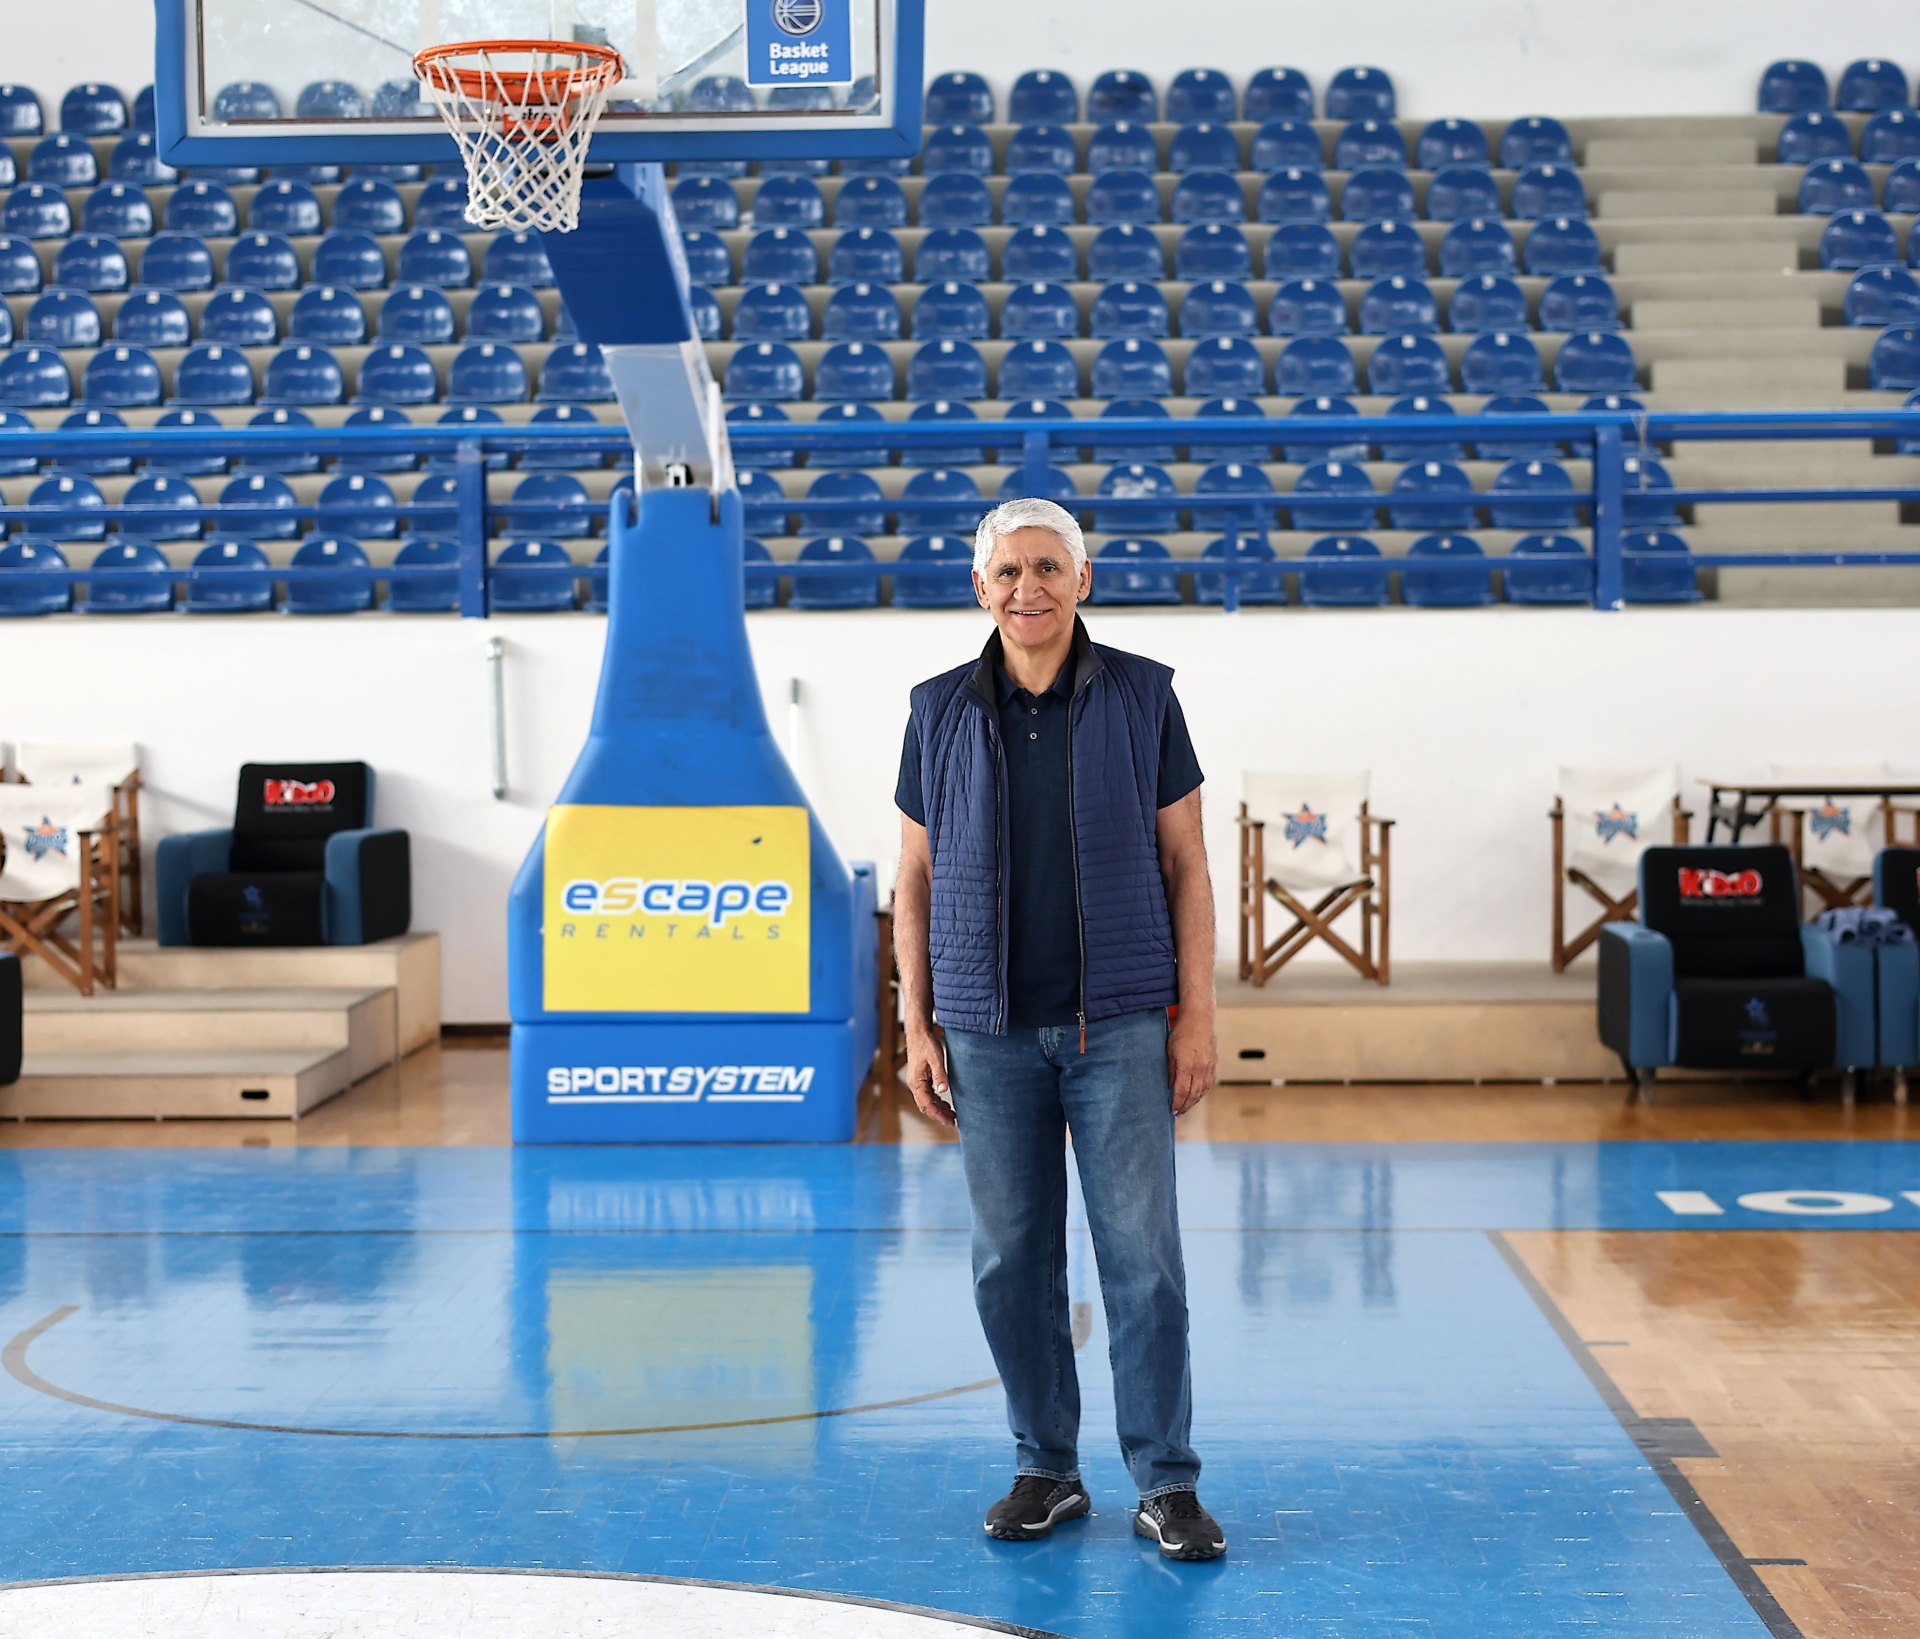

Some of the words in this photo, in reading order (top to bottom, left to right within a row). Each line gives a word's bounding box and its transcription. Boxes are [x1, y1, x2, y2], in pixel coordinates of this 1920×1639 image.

[769, 41, 829, 59] Basket
[769, 60, 830, 78] League
[561, 923, 780, 939] RENTALS
[547, 1066, 815, 1099] SPORTSYSTEM
[1655, 1190, 1920, 1216] IO
